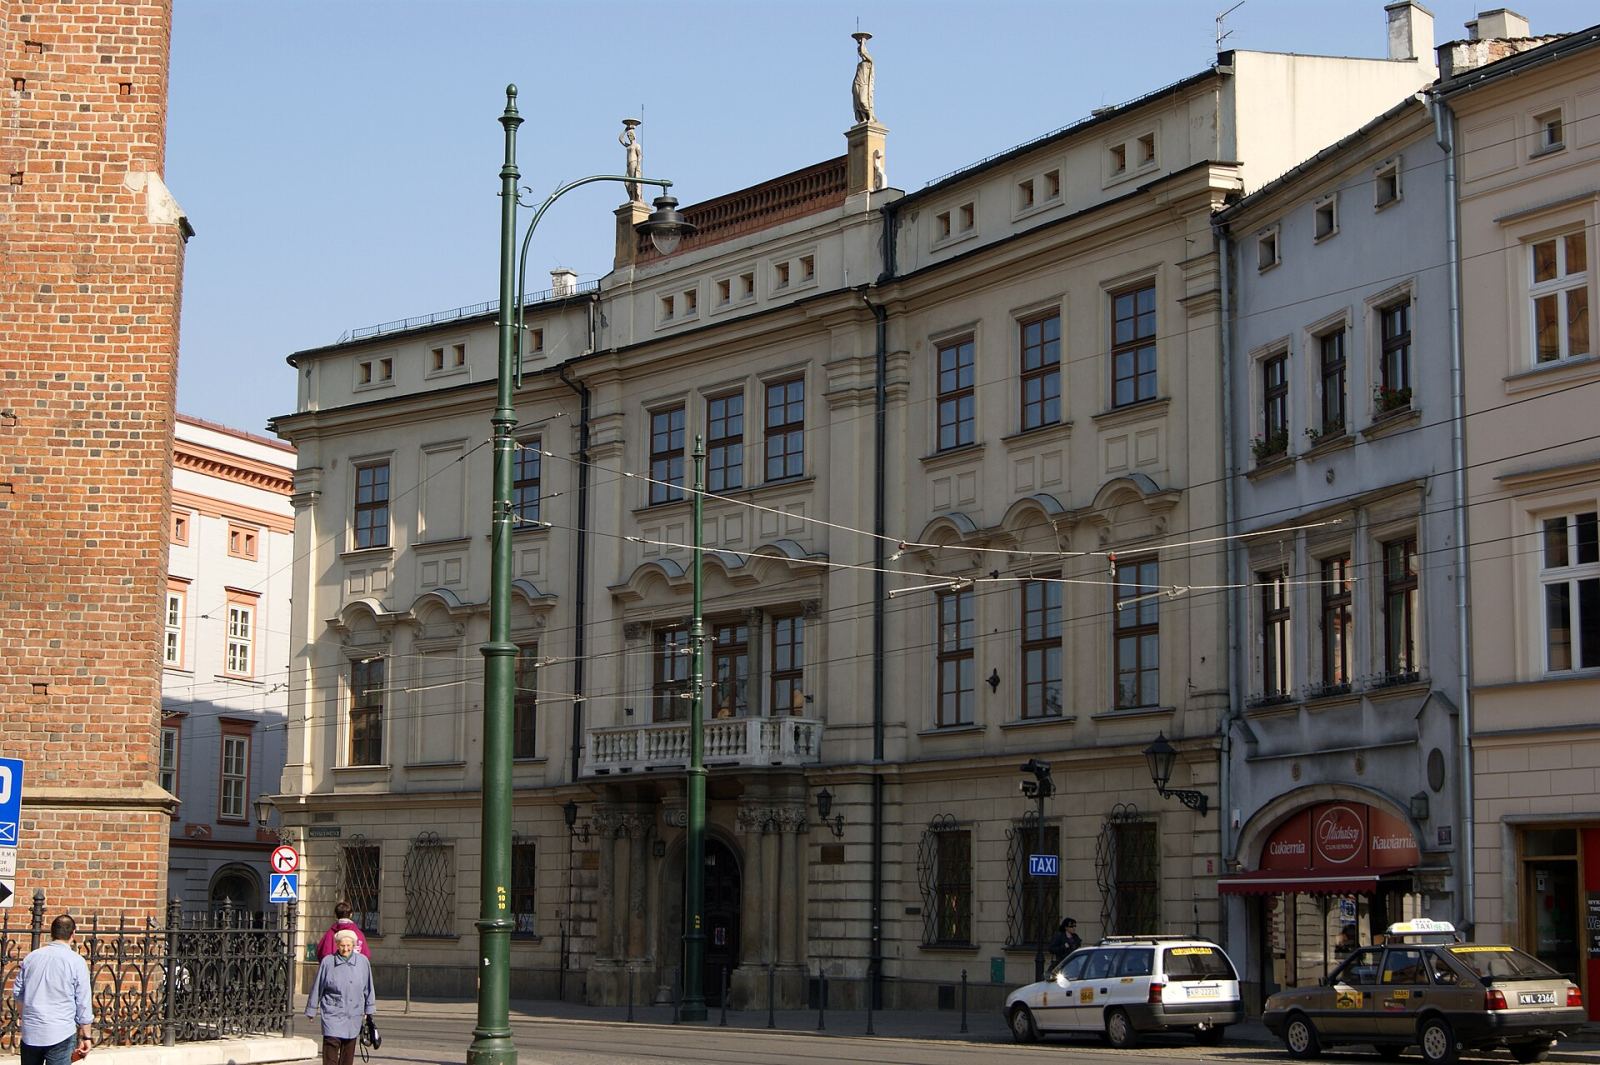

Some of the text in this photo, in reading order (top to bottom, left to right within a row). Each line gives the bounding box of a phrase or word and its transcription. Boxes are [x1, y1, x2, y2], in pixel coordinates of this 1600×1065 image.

[1270, 839, 1306, 855] Cukiernia
[1031, 857, 1056, 873] TAXI
[497, 886, 506, 894] PL
[1416, 922, 1433, 931] TAXI
[1520, 993, 1554, 1004] KWL 2366
